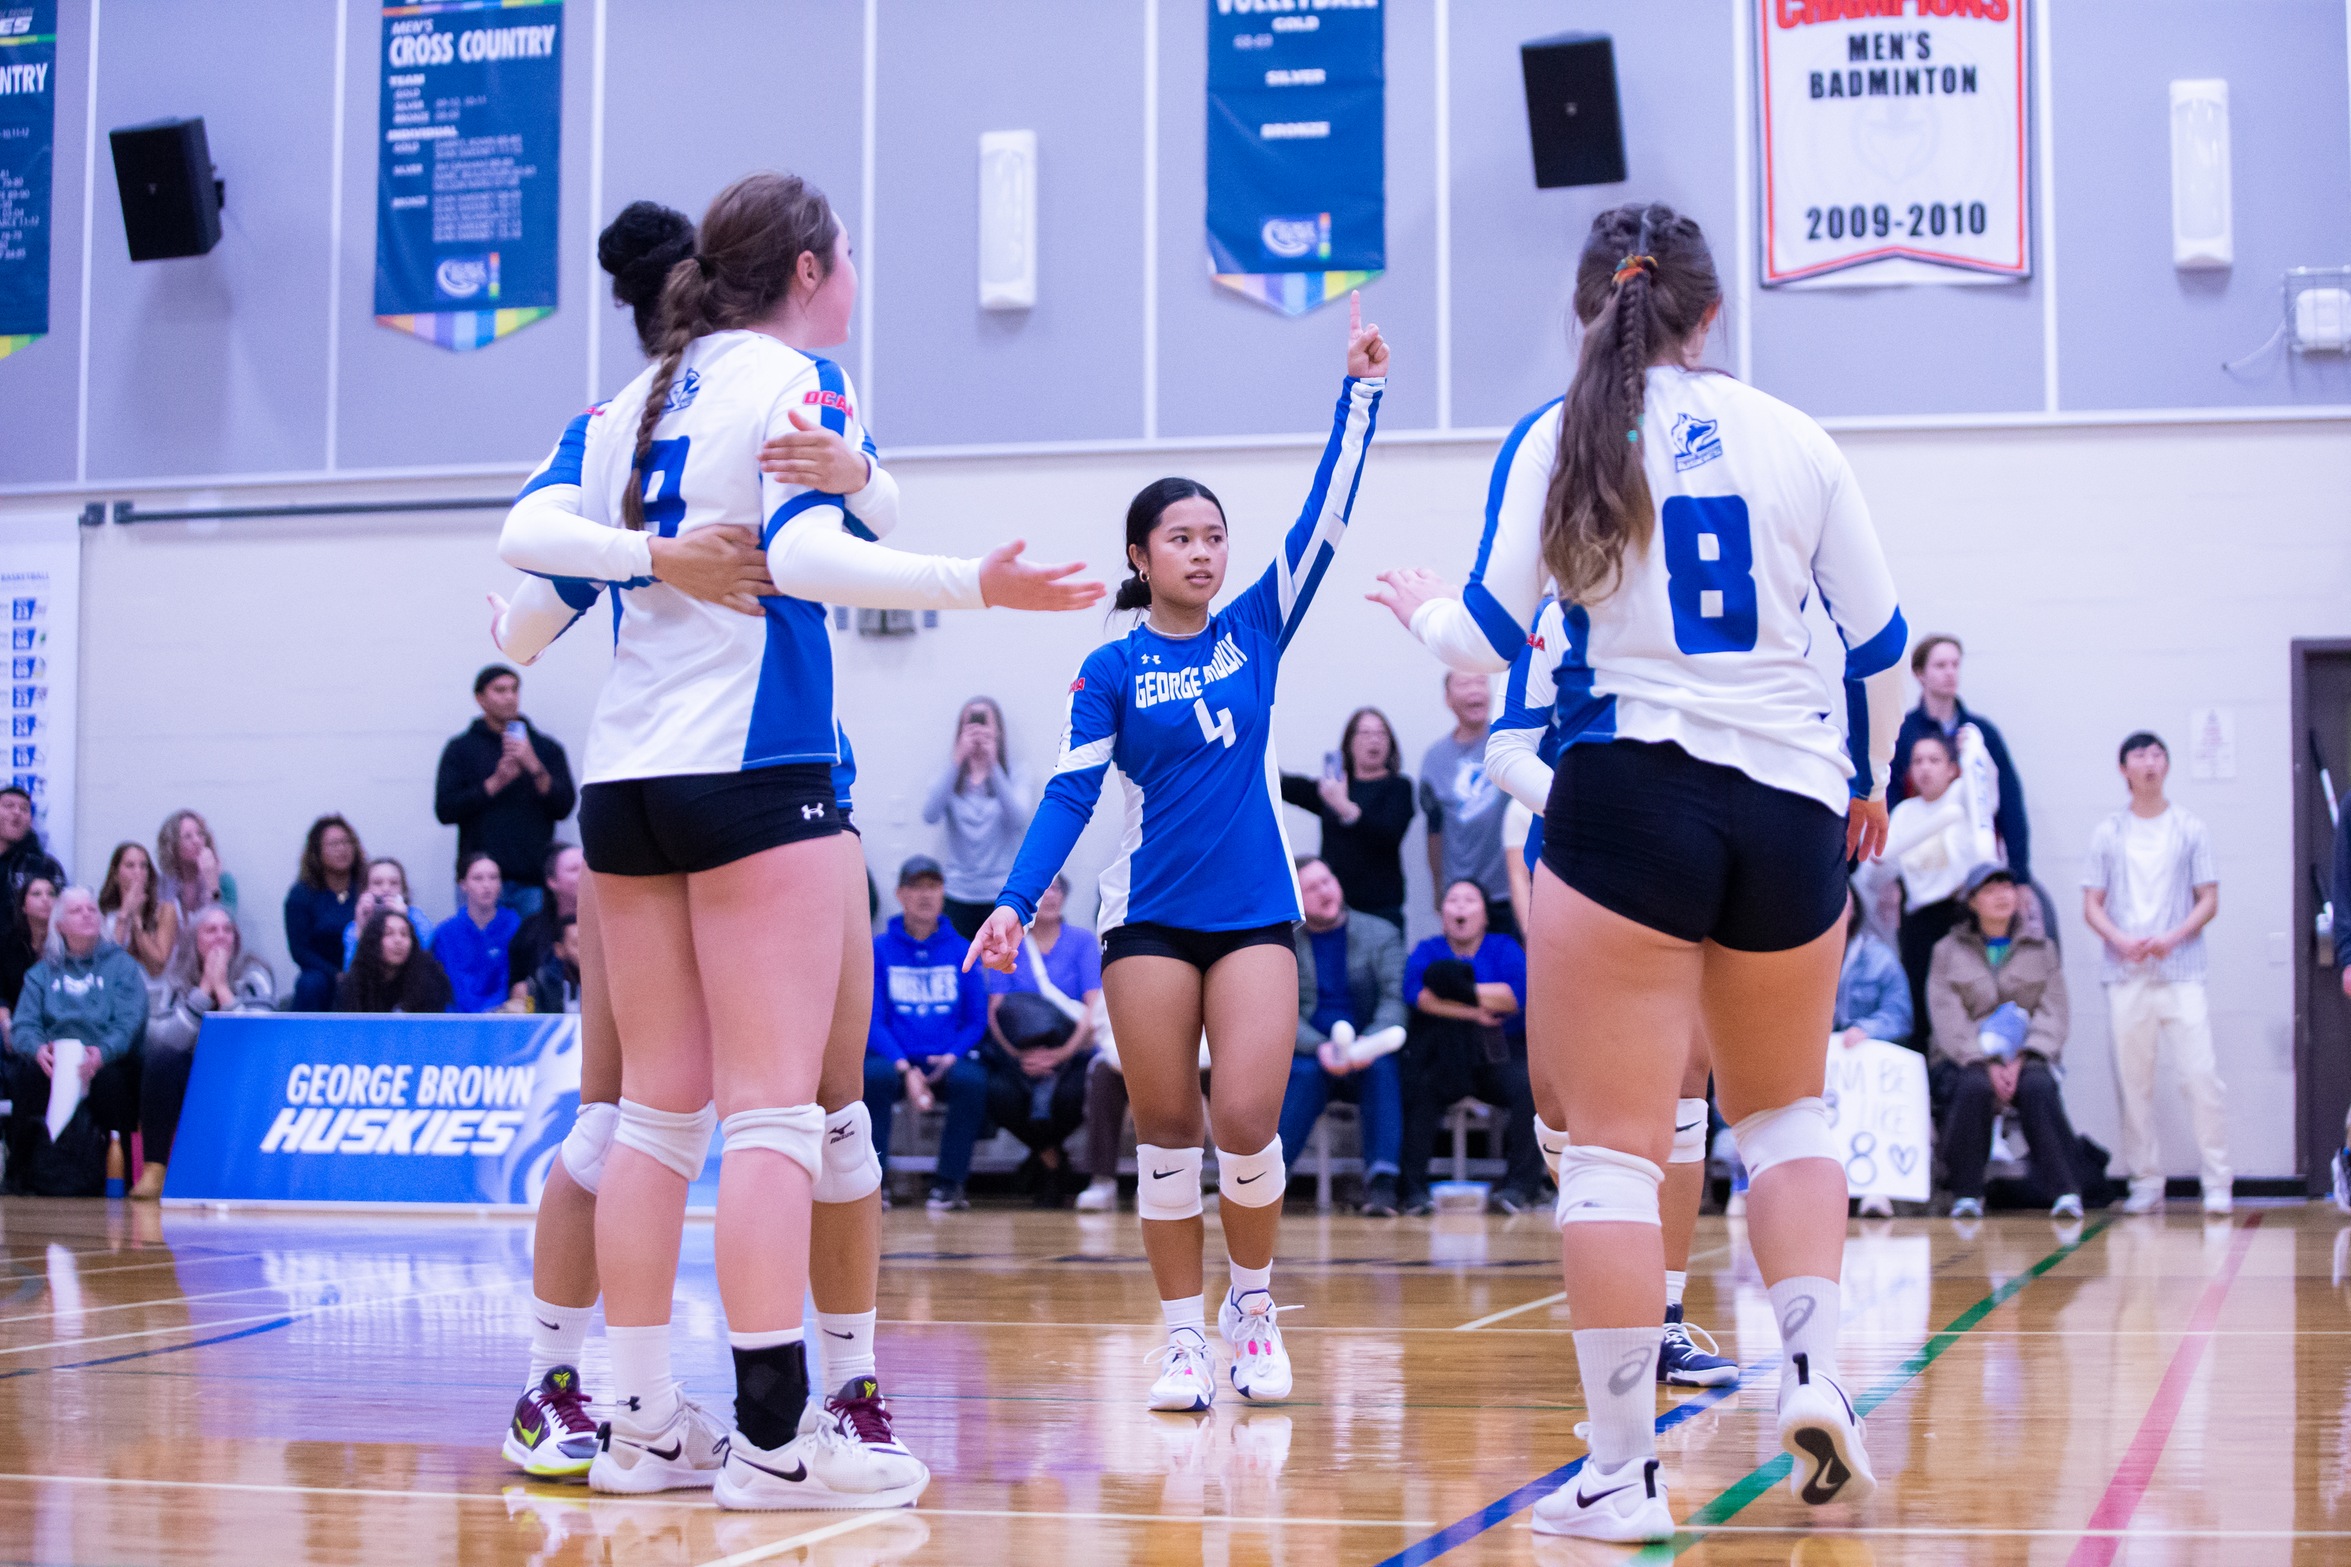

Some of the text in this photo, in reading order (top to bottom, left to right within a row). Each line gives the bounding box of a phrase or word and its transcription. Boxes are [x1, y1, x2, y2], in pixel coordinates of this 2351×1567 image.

[389, 25, 556, 67] CROSS COUNTRY
[1848, 31, 1931, 61] MEN'S
[1810, 65, 1977, 98] BADMINTON
[1806, 201, 1986, 241] 2009-2010
[1662, 494, 1758, 655] 8
[1135, 666, 1203, 709] GEORGE
[1193, 697, 1237, 749] 4
[286, 1063, 536, 1107] GEORGE BROWN
[259, 1107, 525, 1156] HUSKIES
[1845, 1131, 1878, 1187] 8
